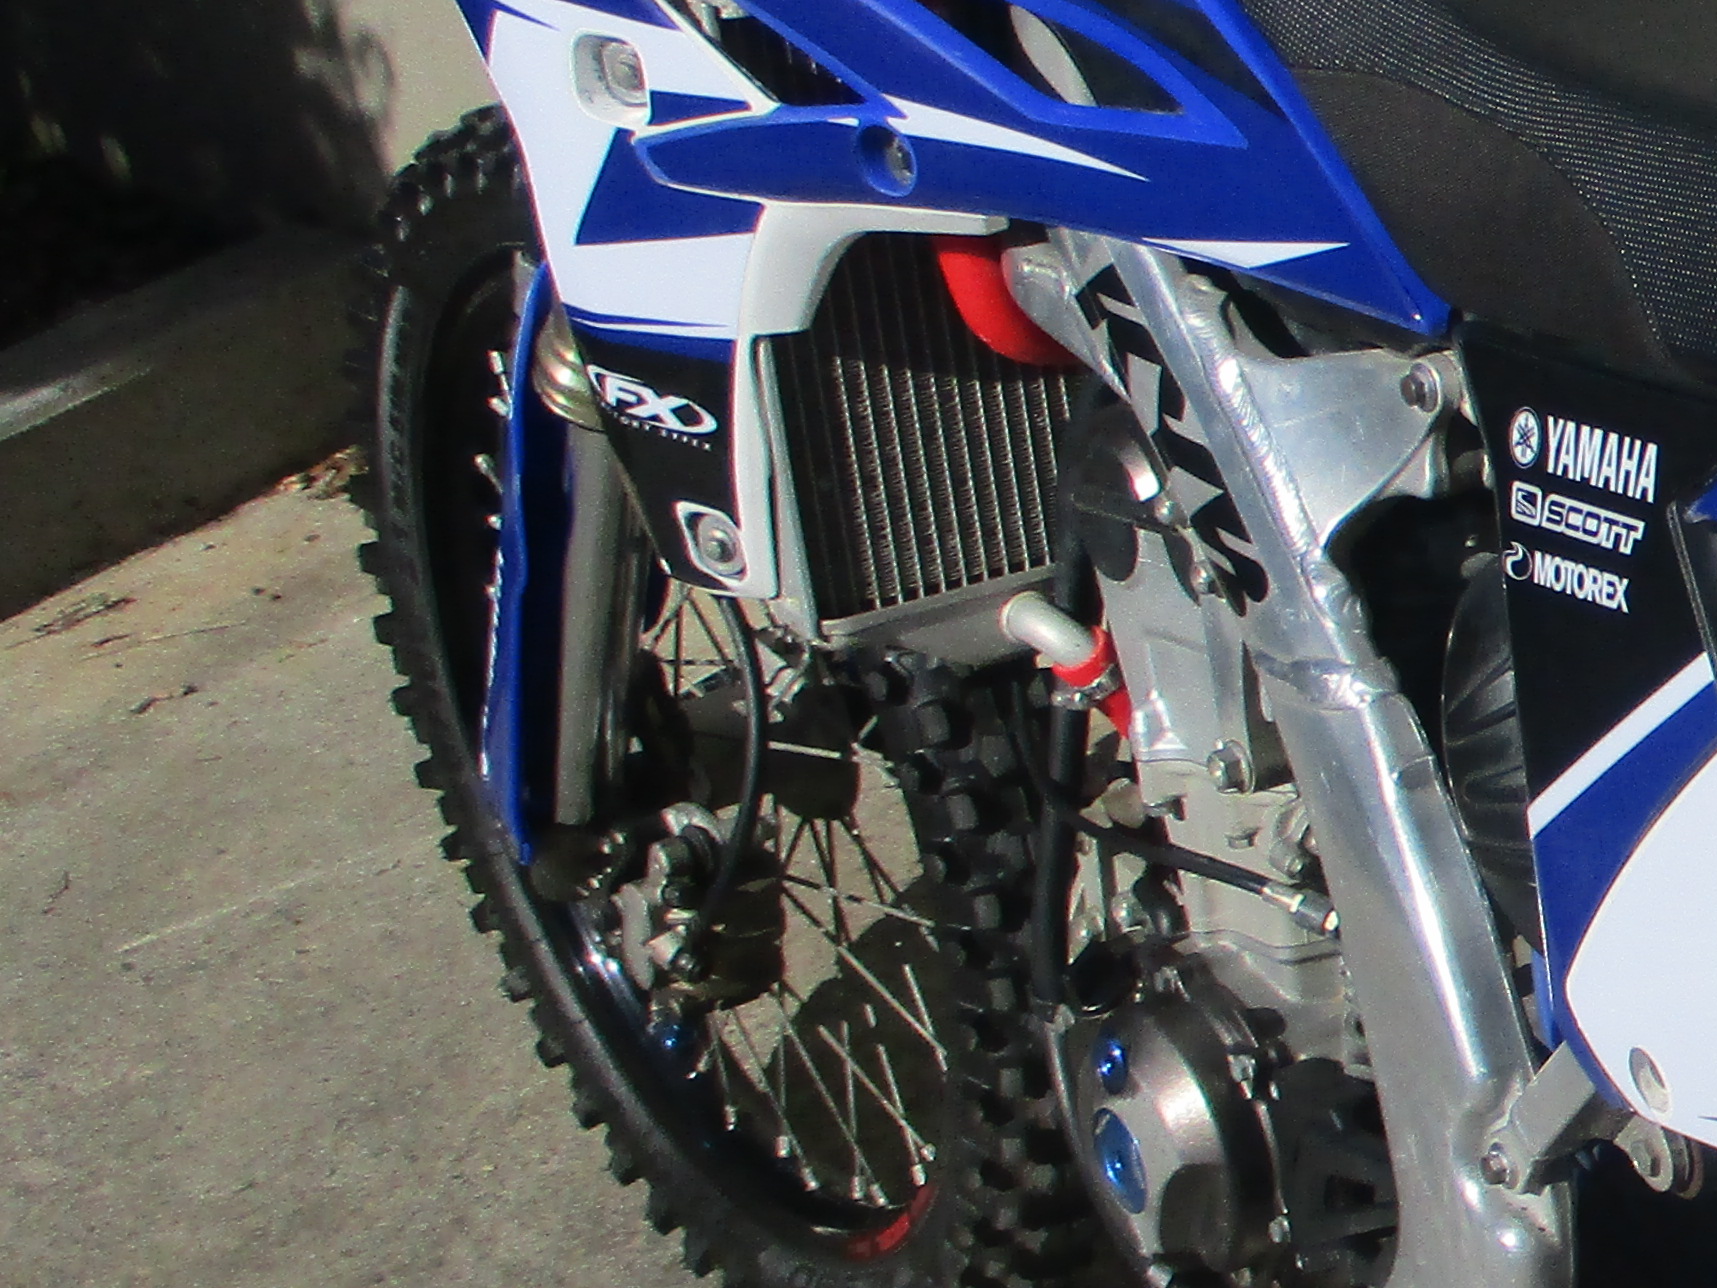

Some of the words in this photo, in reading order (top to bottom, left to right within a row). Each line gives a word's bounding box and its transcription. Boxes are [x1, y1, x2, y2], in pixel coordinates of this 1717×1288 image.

[1546, 414, 1659, 505] YAMAHA
[1543, 494, 1645, 555] SCOTT
[1533, 550, 1630, 614] MOTOREX
